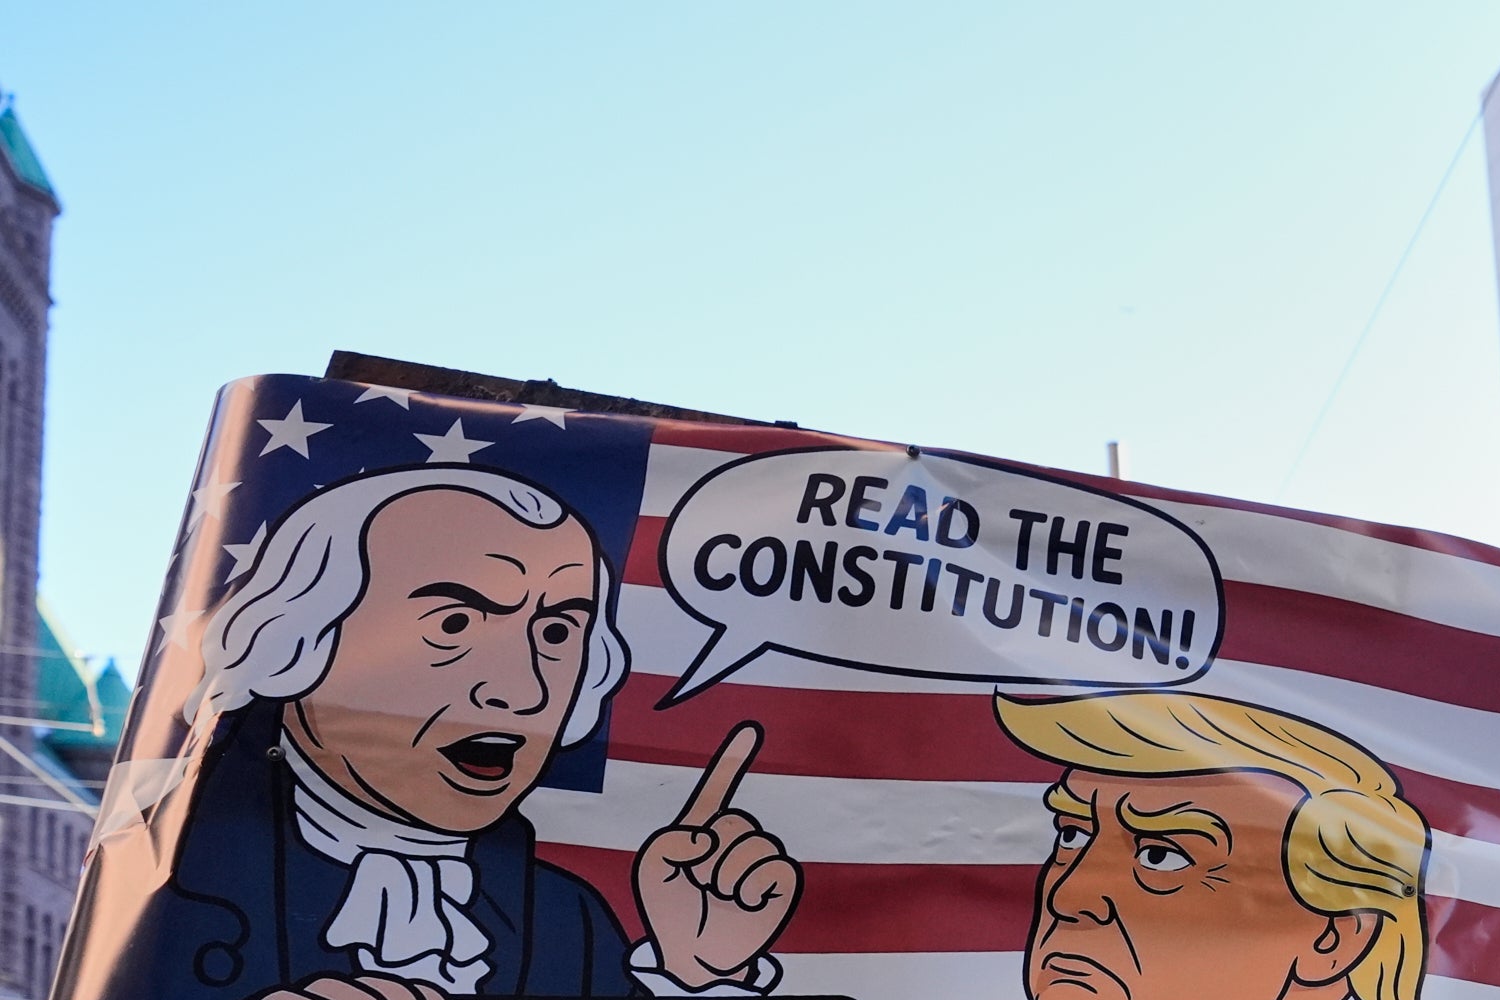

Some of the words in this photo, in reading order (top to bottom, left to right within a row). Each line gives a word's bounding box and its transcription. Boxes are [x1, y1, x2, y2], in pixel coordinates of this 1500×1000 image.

[797, 473, 980, 549] READ
[1009, 509, 1129, 585] THE
[694, 533, 1195, 670] CONSTITUTION!
